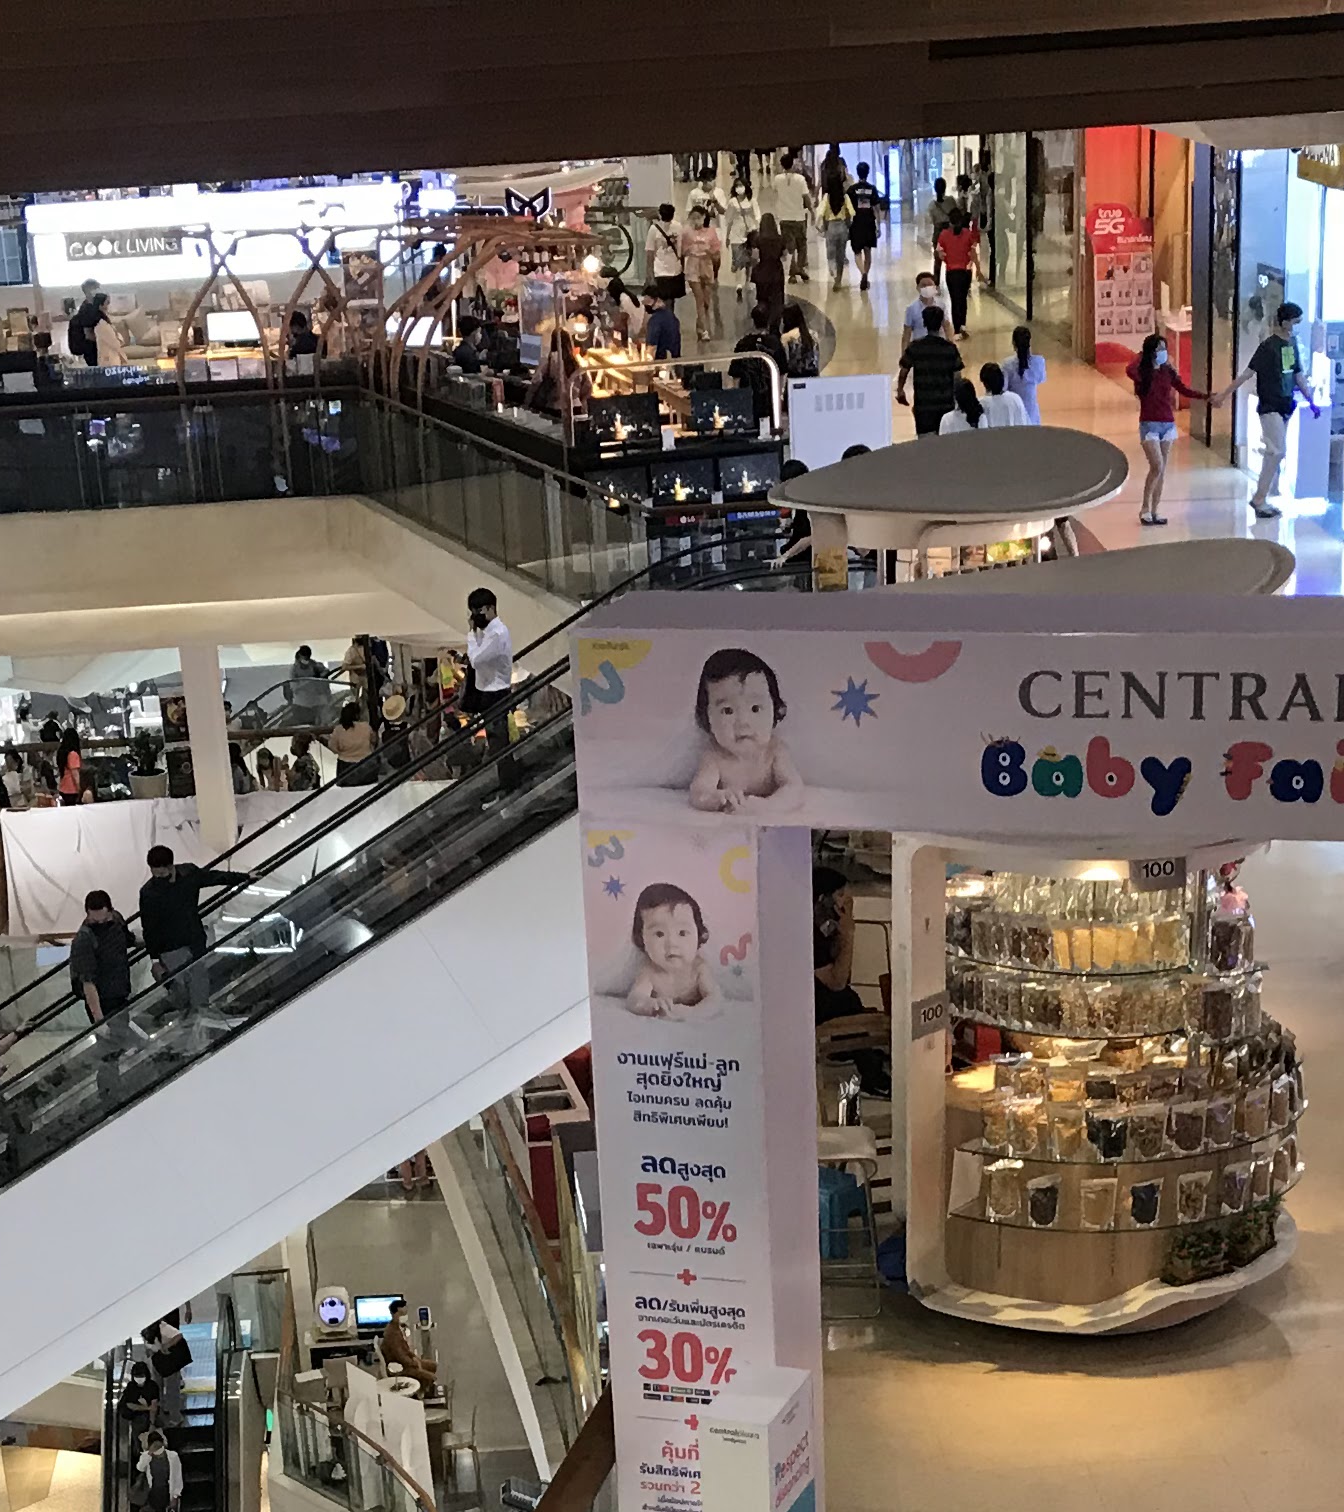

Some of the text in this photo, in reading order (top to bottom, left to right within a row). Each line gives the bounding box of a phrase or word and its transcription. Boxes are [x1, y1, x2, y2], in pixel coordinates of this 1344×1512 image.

[1093, 218, 1125, 235] 5G
[980, 735, 1192, 816] Baby
[1142, 859, 1175, 879] 100
[921, 1003, 944, 1022] 100
[636, 1071, 723, 1093] สุดยิ่งใหญ่
[640, 1154, 727, 1182] ลดสูงสุด
[633, 1182, 737, 1243] 50%
[636, 1328, 737, 1385] 30%
[661, 1438, 701, 1464] คุ้มที่
[639, 1462, 701, 1480] รับสิทธิพิเศ
[690, 1480, 701, 1495] 2
